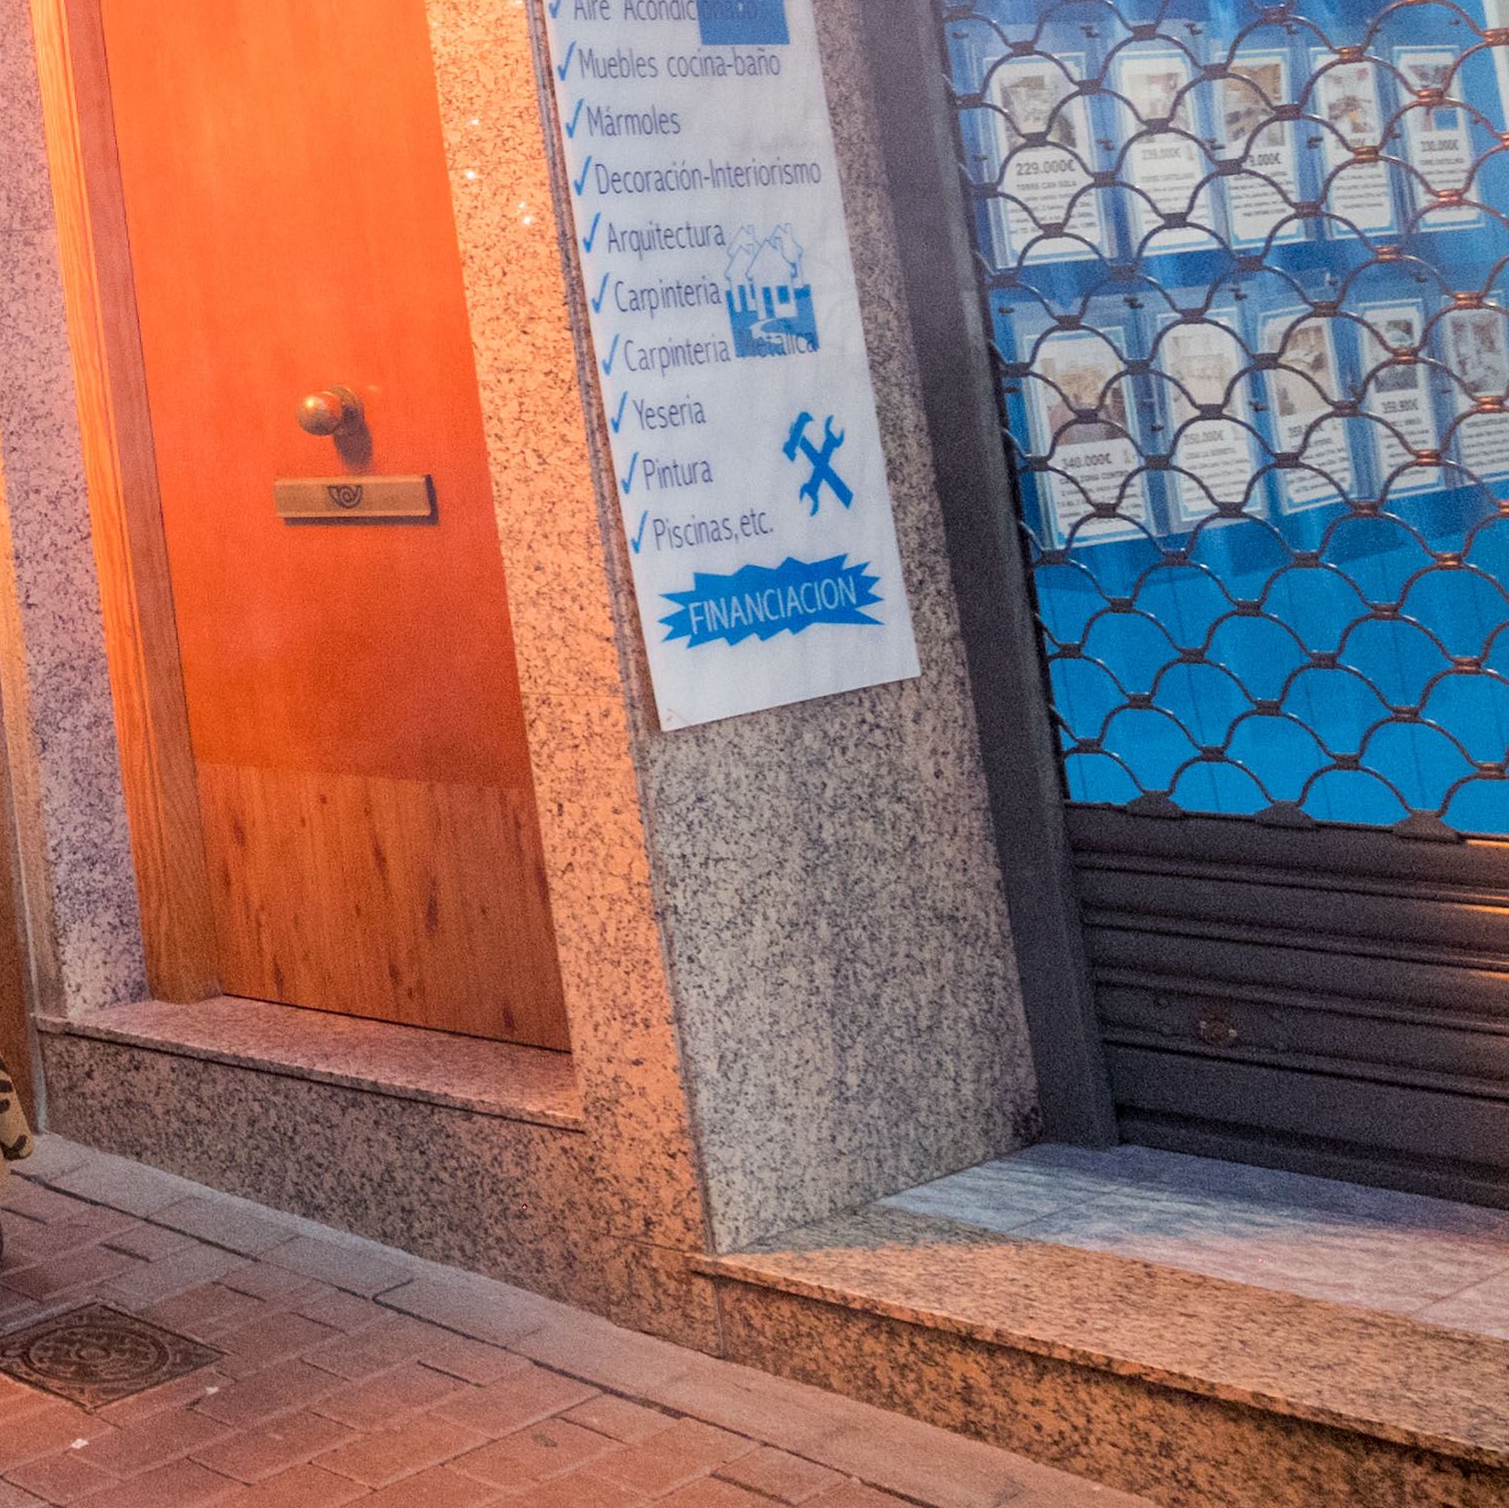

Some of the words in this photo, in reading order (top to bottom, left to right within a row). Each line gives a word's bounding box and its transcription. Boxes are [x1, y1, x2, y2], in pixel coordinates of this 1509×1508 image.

[577, 47, 659, 80] Muebles
[666, 47, 781, 78] cocina-baño
[586, 103, 681, 137] Mármoles
[594, 157, 822, 195] Decoración-Interiorismo
[1015, 158, 1077, 176] 229.000€
[607, 221, 727, 261] Arquitectura
[614, 275, 723, 320] Carpinteria
[624, 333, 731, 377] Carpinteria
[632, 394, 707, 430] Yeseria
[642, 458, 714, 492] Pintura
[688, 575, 858, 635] FINANCIACION
